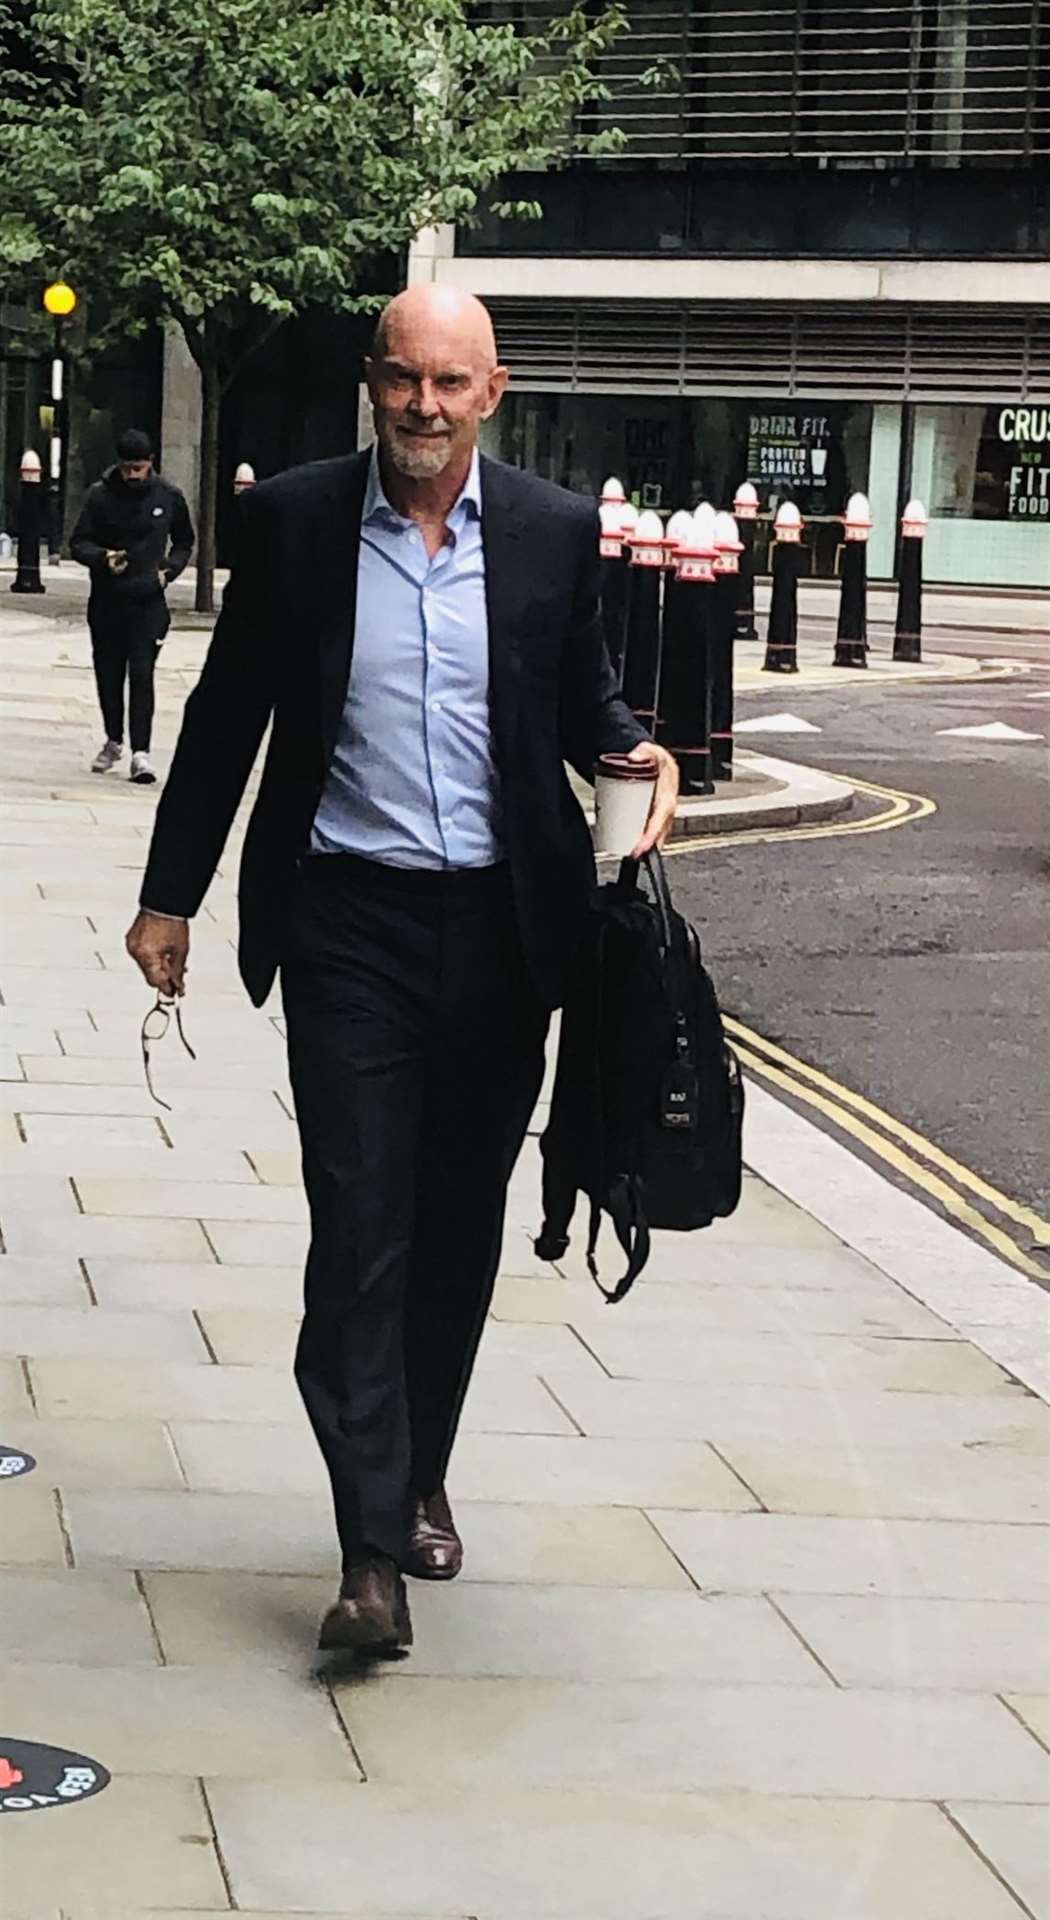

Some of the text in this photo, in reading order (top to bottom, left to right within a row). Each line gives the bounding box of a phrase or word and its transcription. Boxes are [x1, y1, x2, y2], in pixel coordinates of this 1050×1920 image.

[749, 415, 796, 436] DRINK
[760, 460, 806, 475] SHAKES
[1010, 466, 1050, 496] FIT
